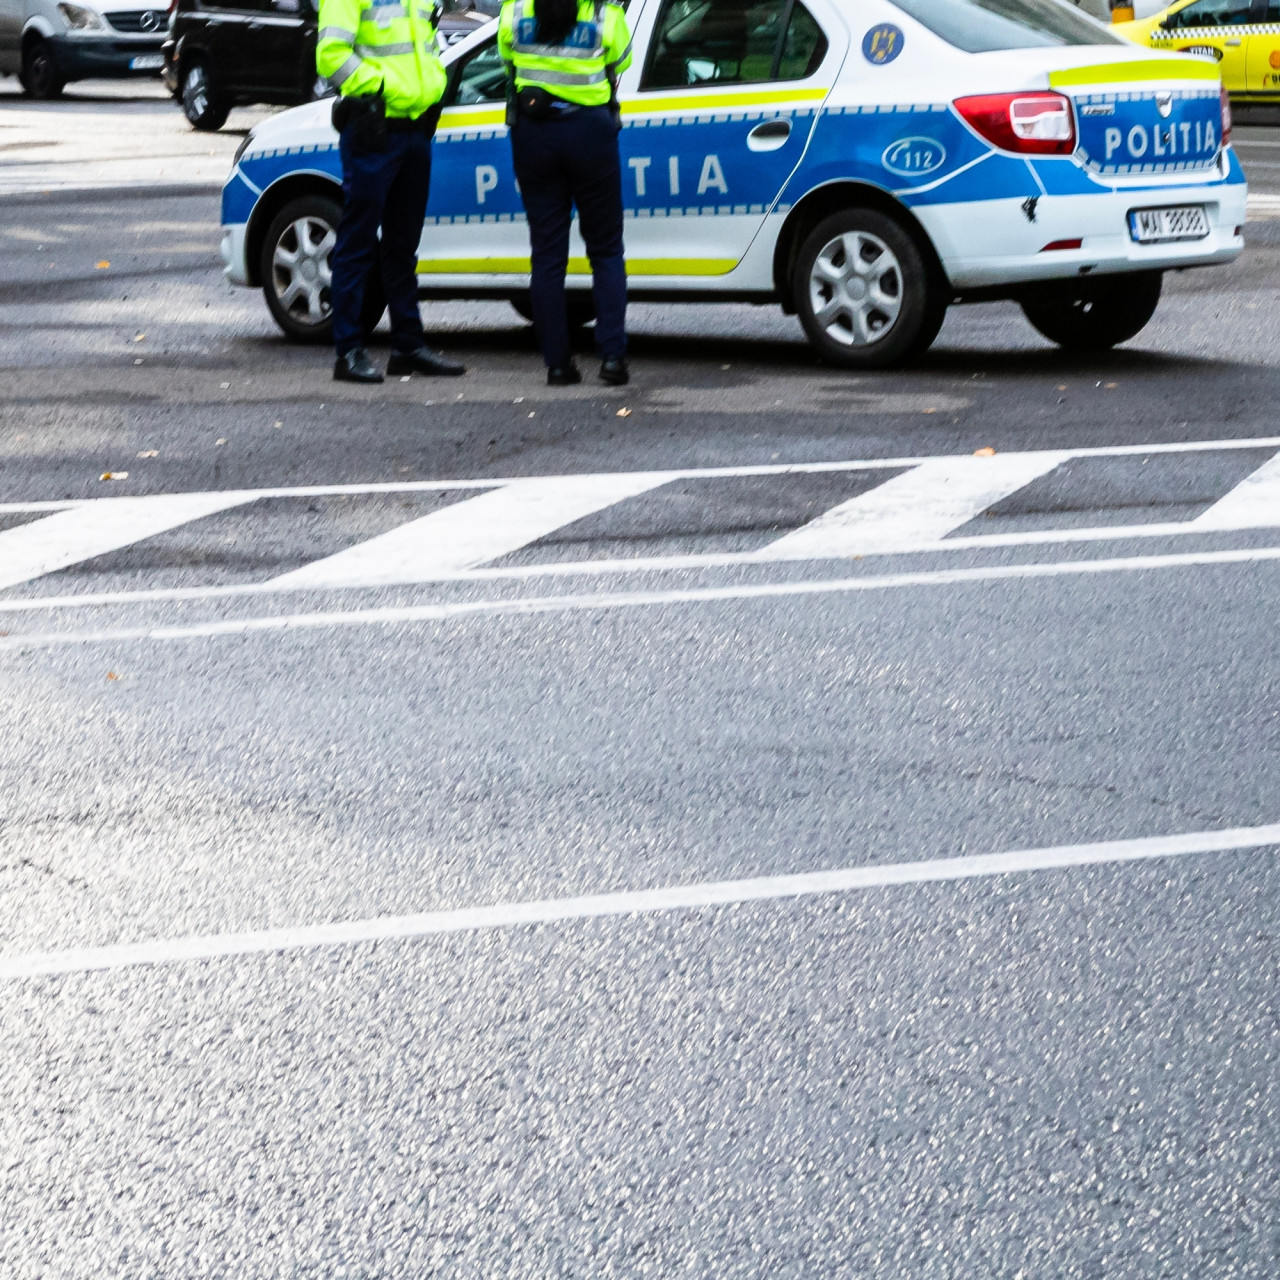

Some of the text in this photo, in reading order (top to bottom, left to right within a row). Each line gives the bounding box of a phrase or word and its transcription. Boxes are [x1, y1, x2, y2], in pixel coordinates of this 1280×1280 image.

[904, 150, 933, 168] 112
[1105, 119, 1217, 161] POLITIA
[474, 154, 729, 205] PTIA
